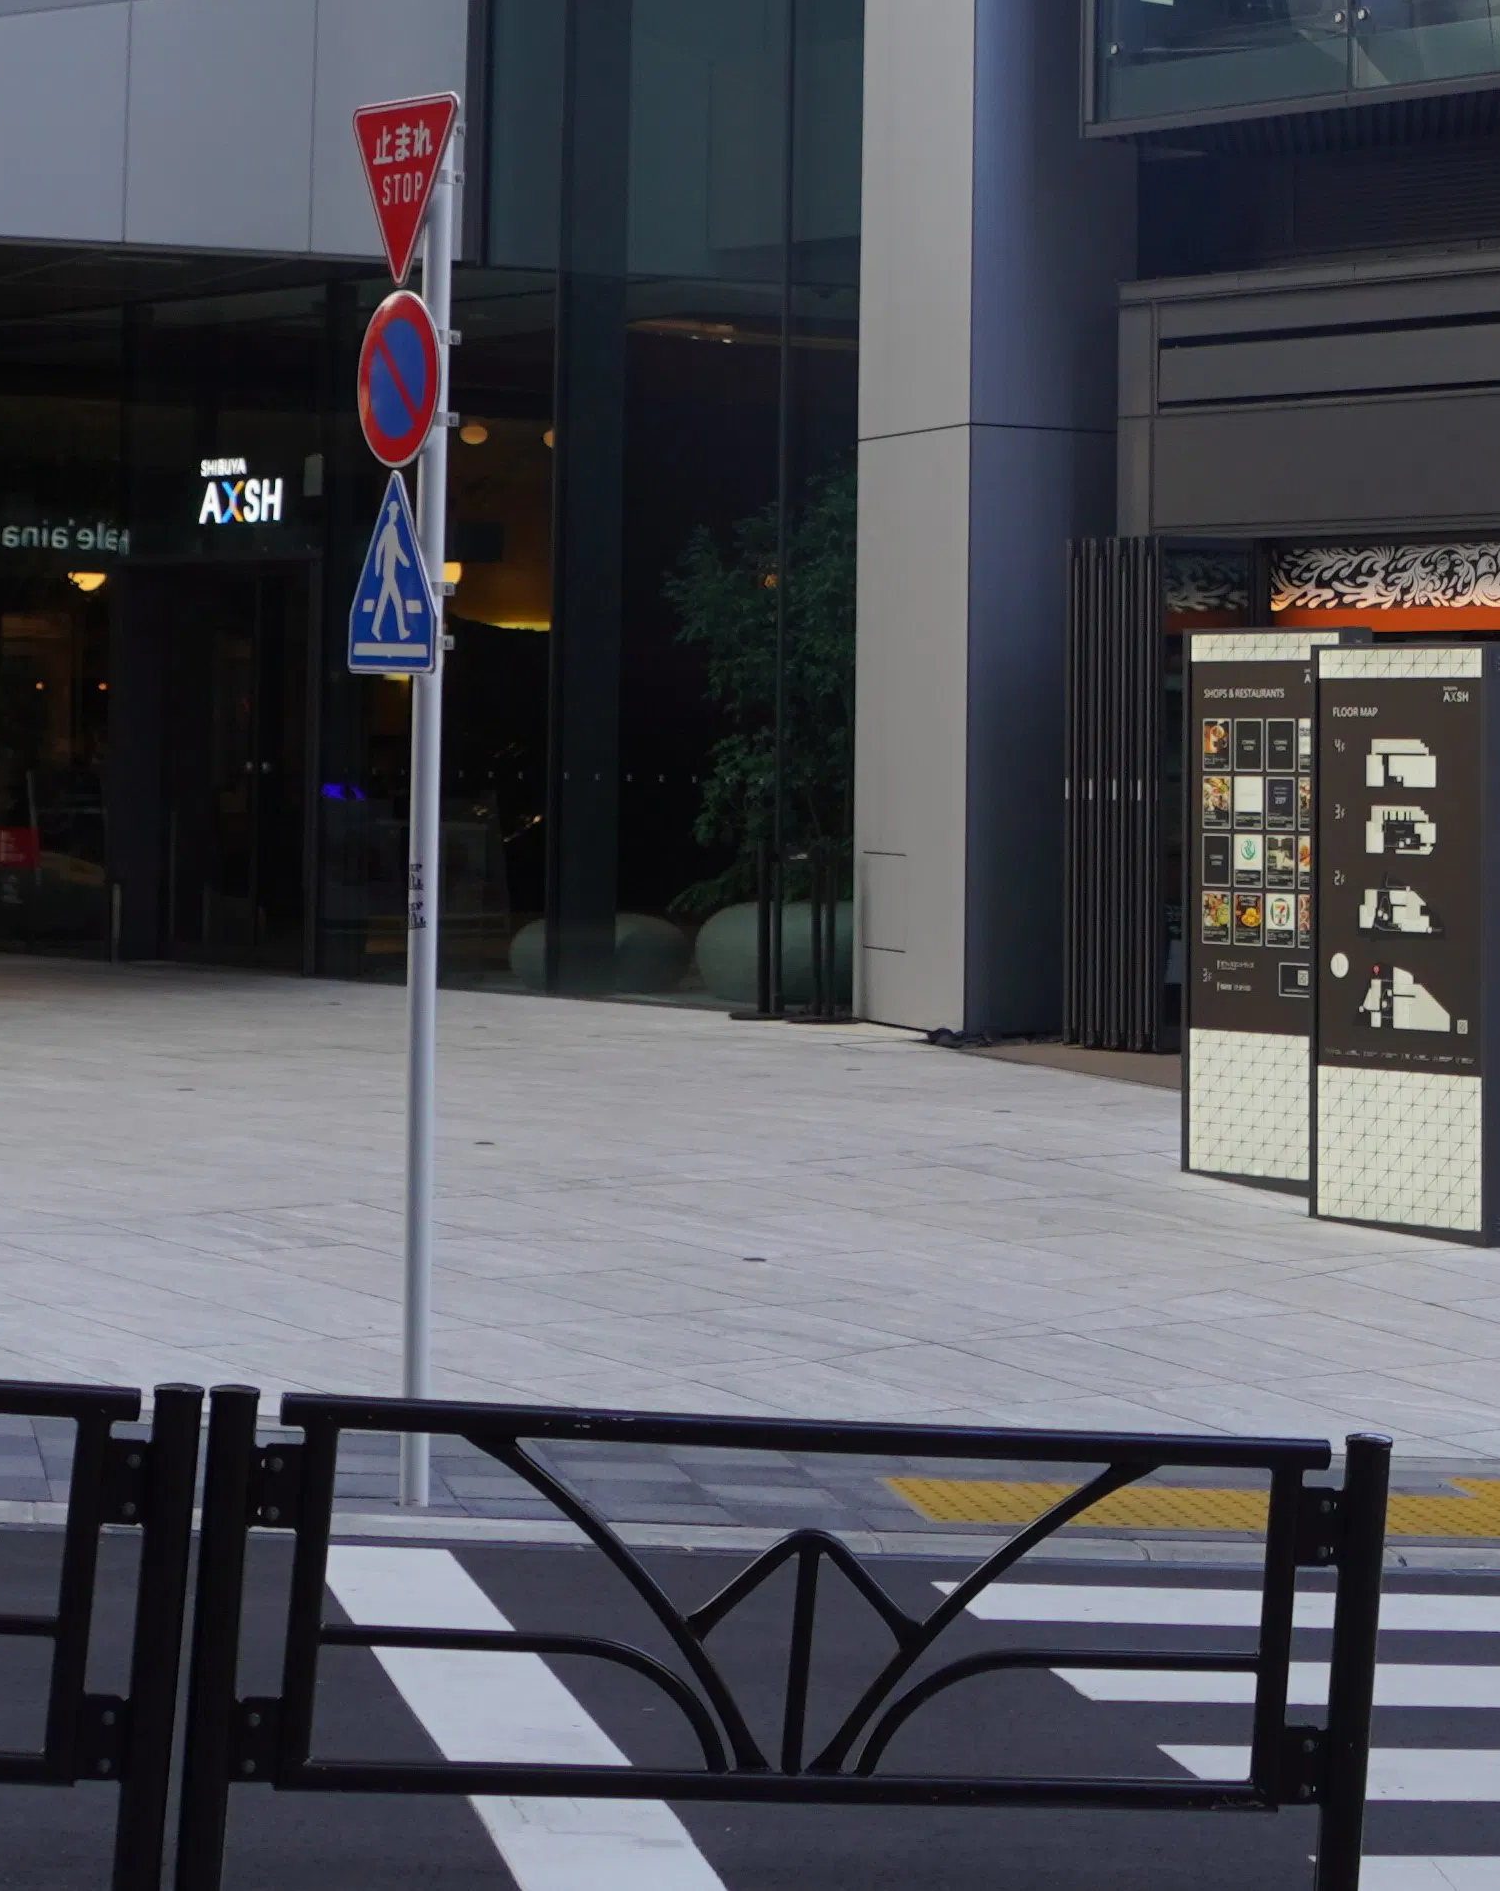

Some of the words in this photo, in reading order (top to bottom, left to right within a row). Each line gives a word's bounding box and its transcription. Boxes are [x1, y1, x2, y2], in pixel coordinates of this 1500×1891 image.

[373, 119, 433, 165] 止まれ
[382, 171, 423, 206] STOP
[200, 458, 247, 477] SHIBUYA
[198, 478, 283, 525] AXSH
[1203, 688, 1228, 699] SHOPS
[1235, 688, 1285, 699] RESTAURANTS
[1443, 691, 1469, 702] AXSH
[1332, 706, 1358, 718] FLOOR
[1360, 706, 1378, 718] MAP
